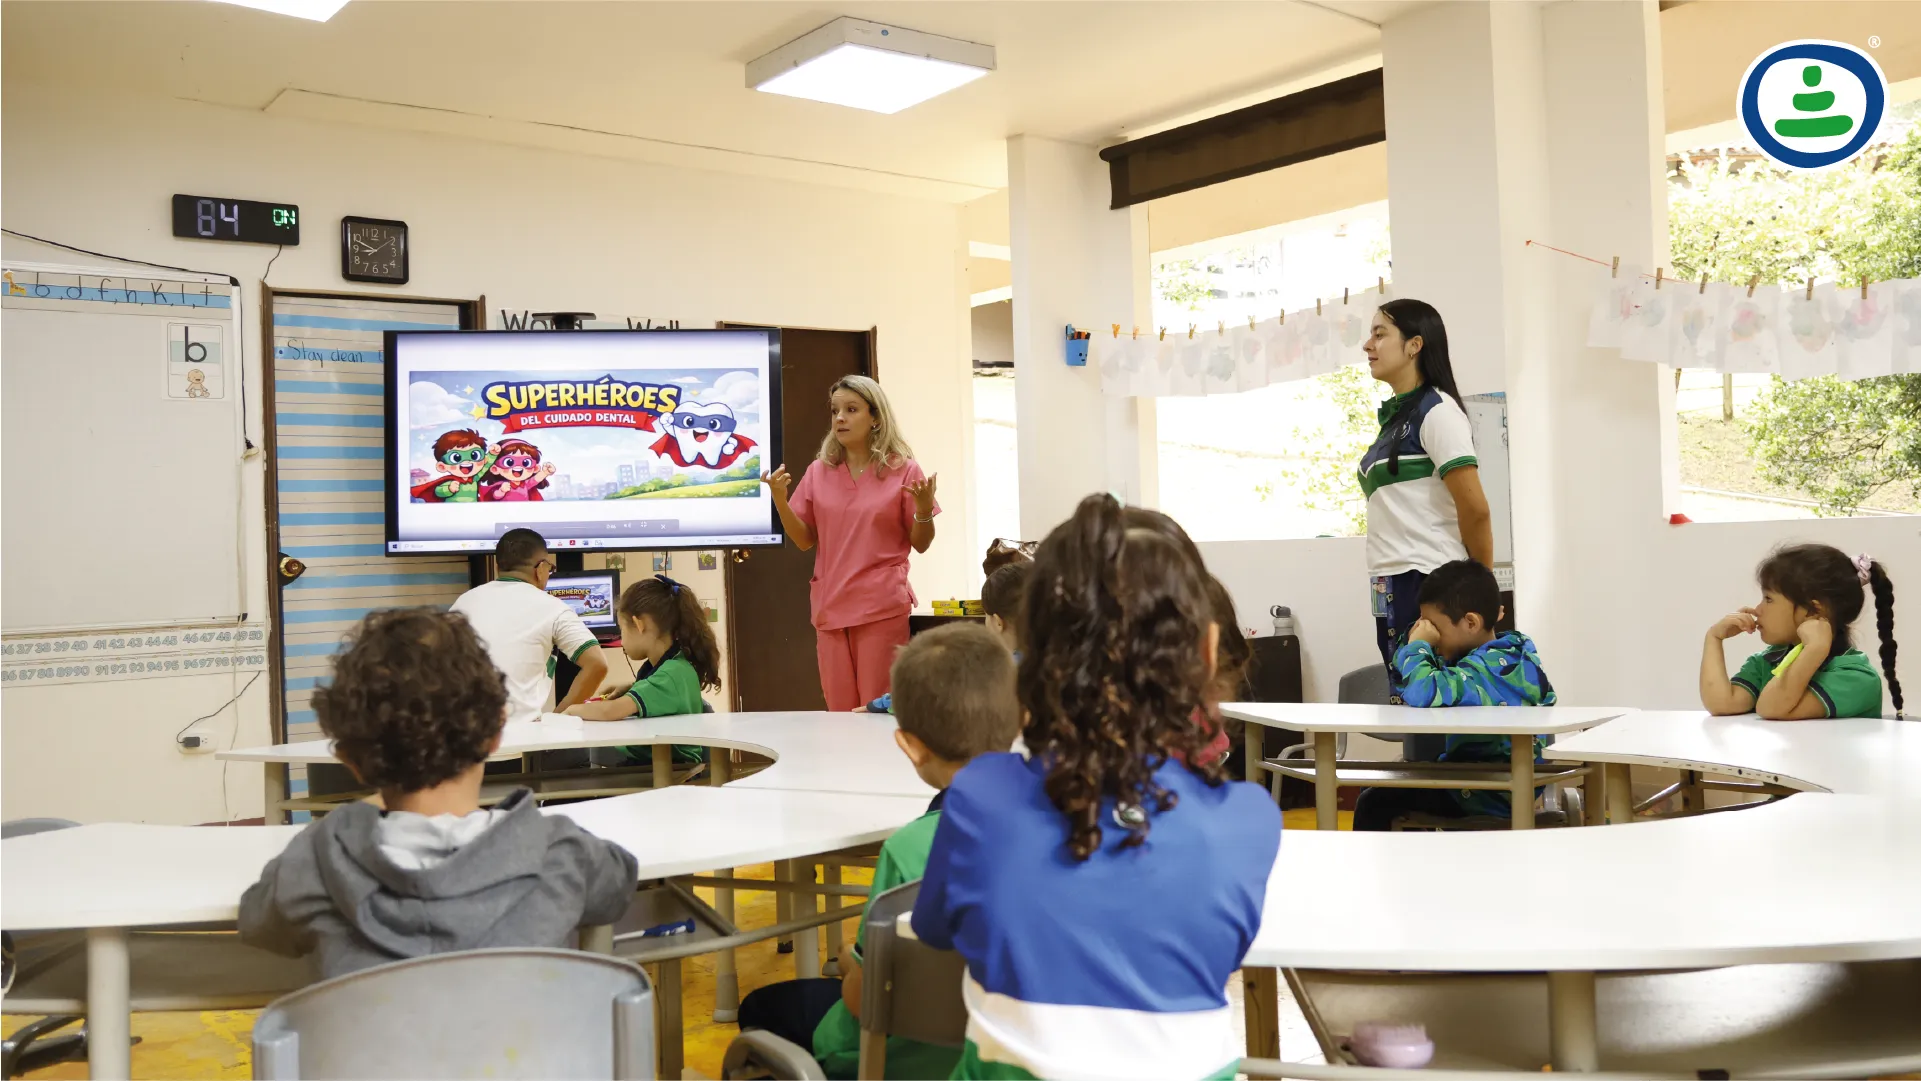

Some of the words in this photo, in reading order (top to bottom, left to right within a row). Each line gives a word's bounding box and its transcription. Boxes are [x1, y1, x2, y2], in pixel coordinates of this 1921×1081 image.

[353, 233, 361, 242] 10
[362, 228, 369, 238] 11
[371, 228, 379, 238] 12
[390, 236, 395, 246] 2
[353, 244, 359, 253] 9
[391, 247, 397, 257] 3
[354, 255, 360, 264] 8
[389, 260, 396, 268] 4
[362, 262, 369, 272] 7
[372, 264, 378, 273] 6
[382, 263, 388, 274] 5
[185, 326, 207, 363] b
[287, 338, 324, 369] Stay
[486, 377, 678, 416] SUPERHÉROES
[520, 415, 541, 426] DEL
[544, 412, 592, 424] CUIDADO
[596, 412, 636, 424] DENTAL
[16, 643, 34, 655] 37
[35, 642, 51, 653] 38
[53, 641, 70, 652] 39
[71, 640, 88, 651] 40
[93, 639, 107, 650] 41
[108, 638, 125, 649] 42
[127, 637, 143, 647] 43
[145, 636, 161, 647] 44
[162, 635, 178, 646] 45
[183, 632, 199, 643] 46
[199, 632, 216, 642] 47
[216, 631, 231, 641] 48
[249, 630, 263, 640] 50
[19, 669, 36, 680] 87
[37, 667, 54, 678] 88
[56, 666, 73, 677] 89
[73, 665, 90, 676] 90
[95, 664, 109, 676] 91
[110, 663, 127, 675] 92
[129, 662, 145, 673] 93
[146, 661, 162, 672] 94
[163, 660, 179, 671] 95
[183, 659, 199, 670] 96
[199, 657, 214, 668] 97
[214, 656, 229, 667] 98
[246, 655, 264, 665] 100
